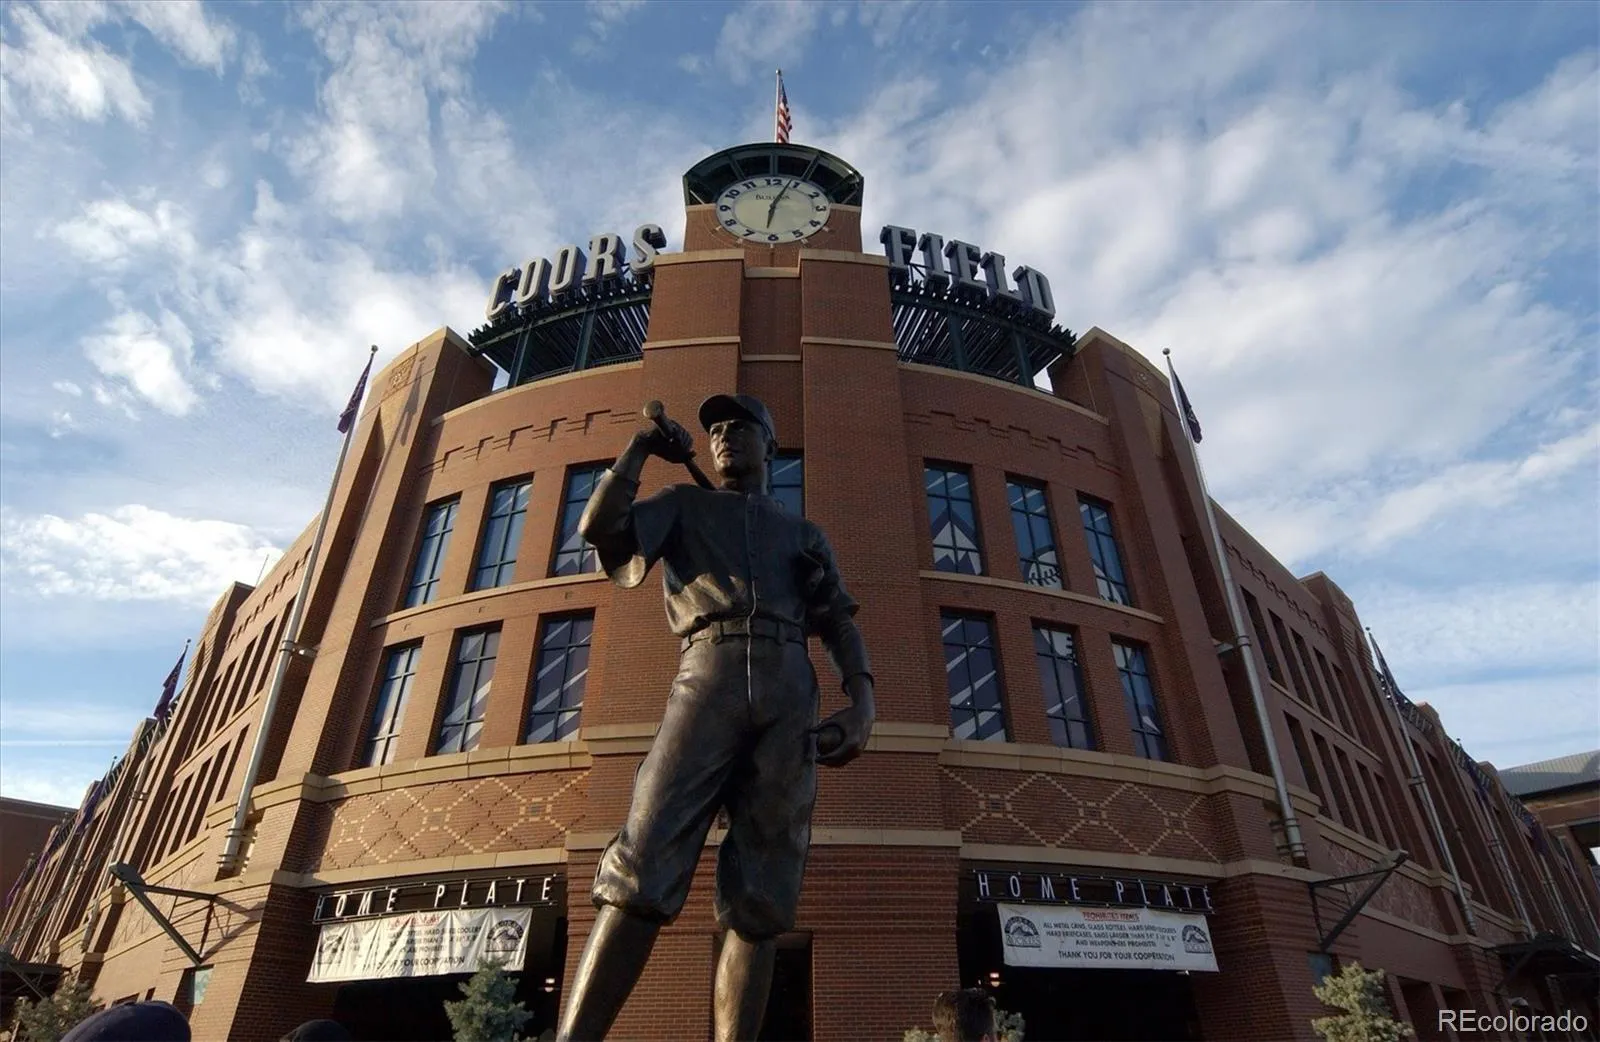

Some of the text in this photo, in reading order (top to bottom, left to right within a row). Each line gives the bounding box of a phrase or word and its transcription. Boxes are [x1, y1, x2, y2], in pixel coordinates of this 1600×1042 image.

[742, 181, 757, 189] 11
[764, 178, 782, 186] 12
[725, 189, 740, 199] 10
[808, 191, 820, 199] 2
[725, 219, 737, 227] 8
[809, 219, 821, 228] 4
[744, 229, 756, 237] 7
[792, 230, 804, 238] 5
[485, 223, 1056, 322] COORS FIELD
[978, 873, 1213, 910] HOME PLATE
[313, 878, 552, 921] HOME PLATE
[1058, 949, 1082, 958] THANK
[1083, 950, 1099, 959] YOU
[1100, 950, 1113, 959] FOR
[1114, 951, 1132, 960] YOUR
